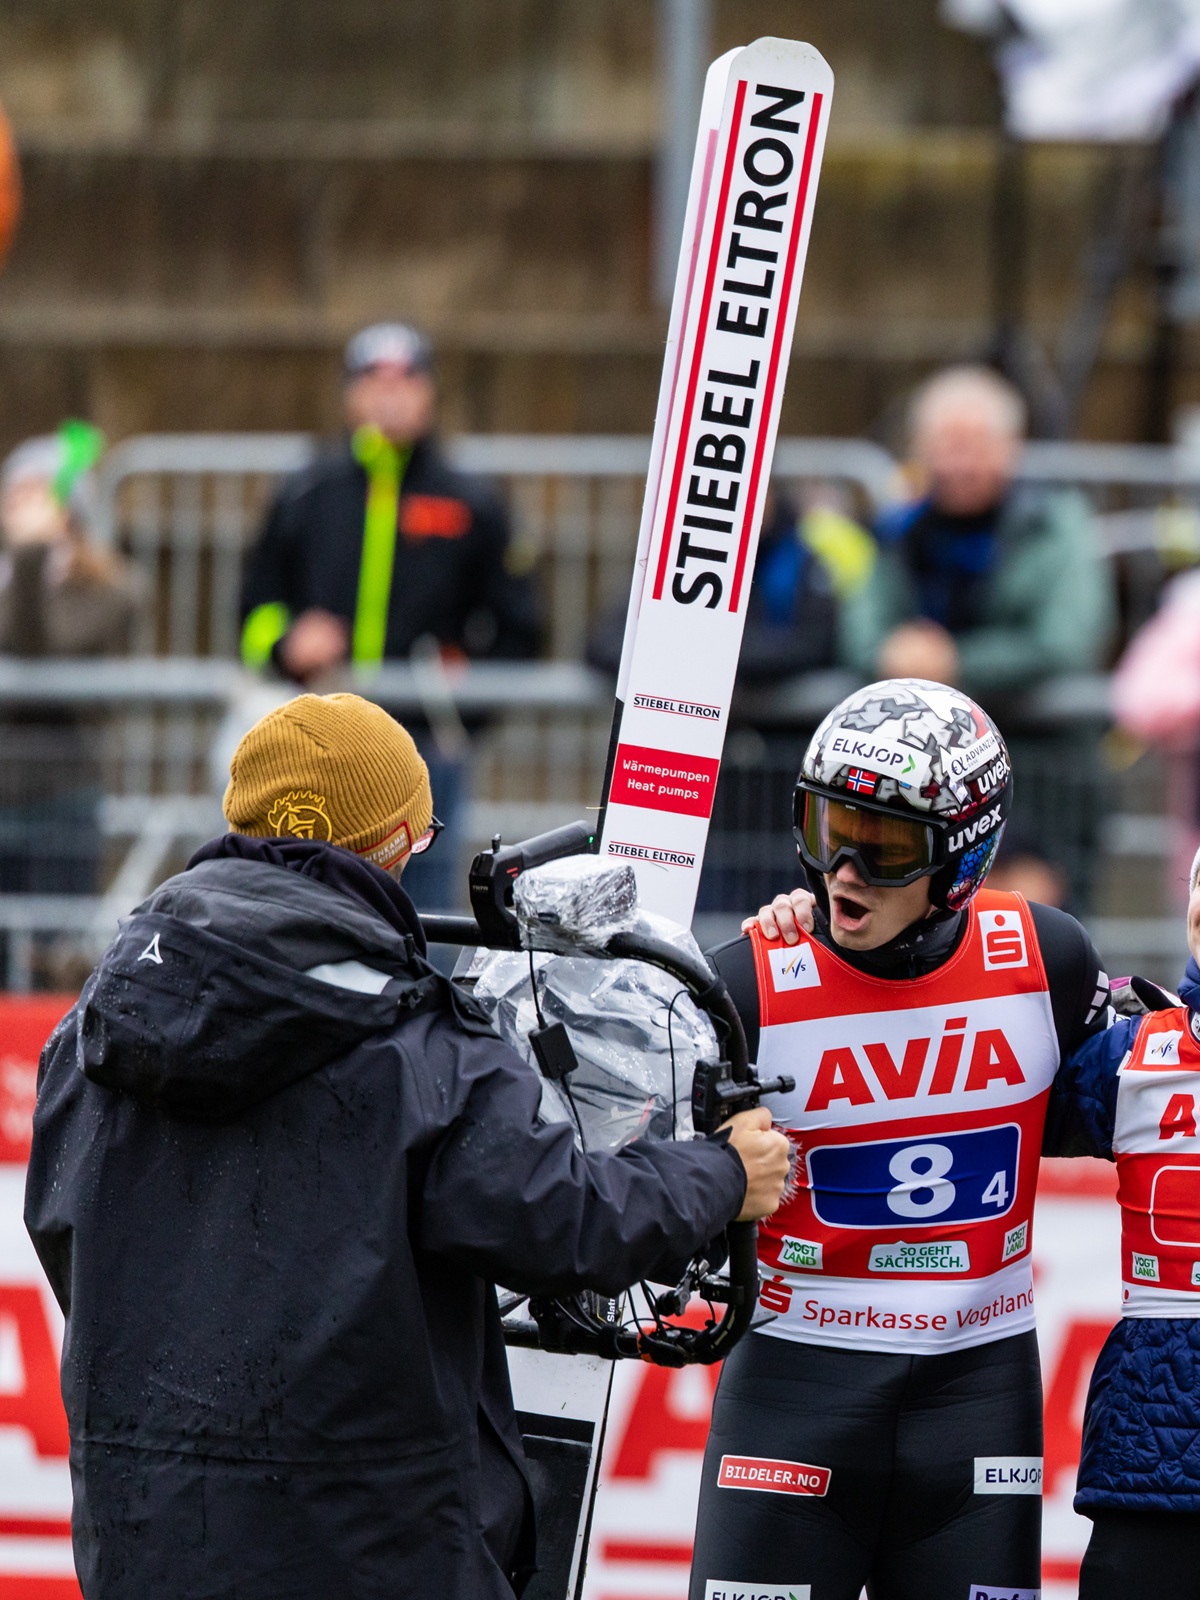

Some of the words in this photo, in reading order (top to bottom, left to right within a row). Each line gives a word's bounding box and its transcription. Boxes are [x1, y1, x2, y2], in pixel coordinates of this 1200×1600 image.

[716, 84, 806, 338] ELTRON
[672, 360, 761, 609] STIEBEL
[633, 696, 675, 712] STIEBEL
[678, 703, 721, 719] ELTRON
[965, 736, 996, 763] ADVANZIA
[622, 759, 710, 783] Wärmepumpen
[977, 754, 1010, 794] uvex
[627, 778, 655, 793] Heat
[658, 784, 699, 800] pumps
[948, 803, 1002, 853] uvex
[608, 843, 650, 859] STIEBEL
[652, 850, 695, 866] ELTRON
[886, 1143, 956, 1218] 8
[981, 1170, 1009, 1208] 4
[1006, 1225, 1026, 1245] VOGT
[785, 1239, 818, 1257] VOGT
[900, 1246, 917, 1256] SO
[919, 1245, 952, 1256] GEHT
[1005, 1238, 1025, 1256] LAND
[783, 1251, 817, 1267] LAND
[875, 1255, 963, 1269] SÄCHSISCH.
[1135, 1256, 1155, 1269] VOGT
[1135, 1266, 1156, 1279] LAND
[802, 1299, 948, 1331] Sparkasse
[956, 1288, 1034, 1329] Vogtland
[725, 1464, 821, 1489] BILDELER.NO
